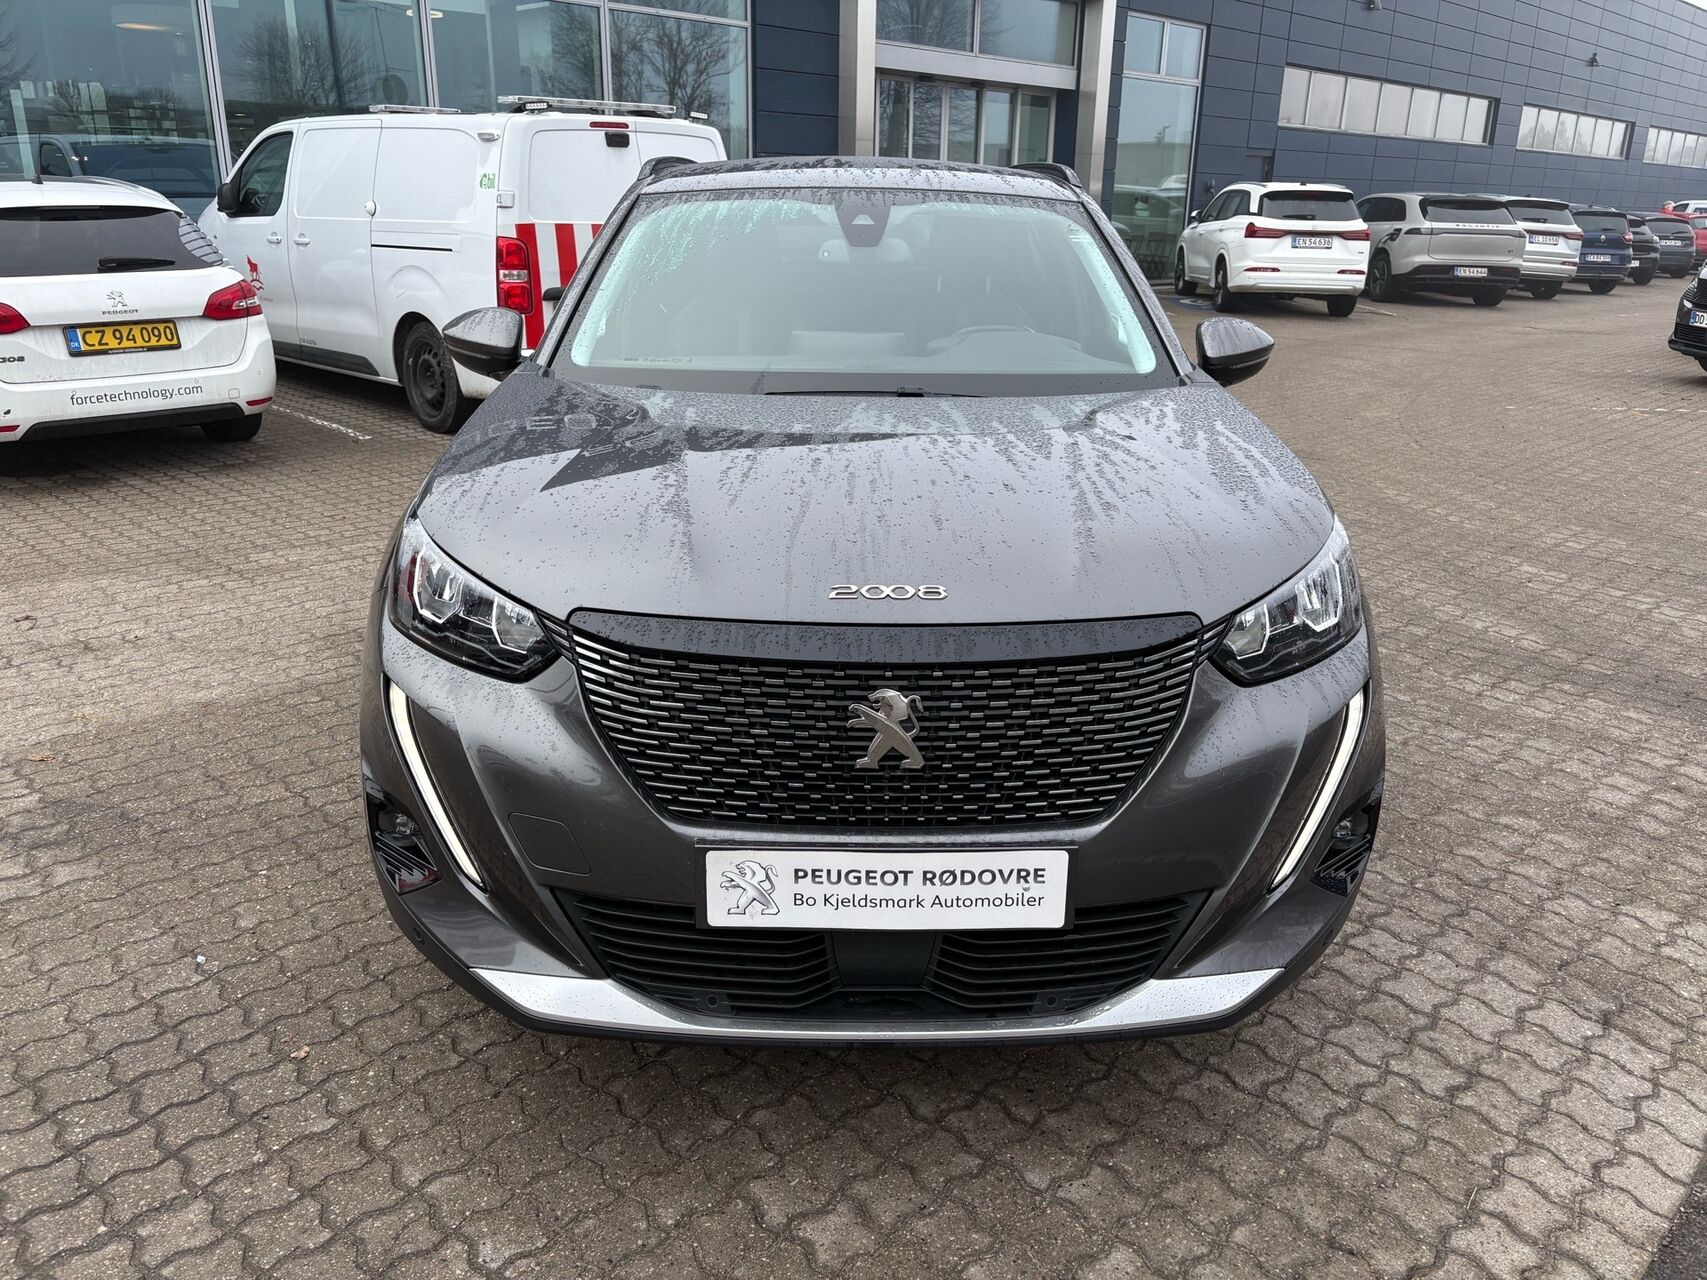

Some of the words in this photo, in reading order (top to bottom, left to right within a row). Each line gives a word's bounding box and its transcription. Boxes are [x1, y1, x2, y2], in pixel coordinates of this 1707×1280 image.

[1297, 238, 1307, 246] EN
[1308, 238, 1317, 246] 54
[1318, 238, 1331, 247] 636
[101, 308, 139, 316] PEUGEOT
[81, 329, 109, 347] CZ
[112, 327, 137, 346] 94
[140, 324, 175, 344] 090
[70, 385, 203, 406] forcetechnology.com
[828, 584, 948, 600] 2008
[793, 867, 914, 887] PEUGEOT
[922, 867, 1046, 887] RØDOVRE
[793, 893, 817, 907] Bo
[823, 892, 926, 910] Kjeldsmark
[930, 893, 1045, 908] Automobiler
